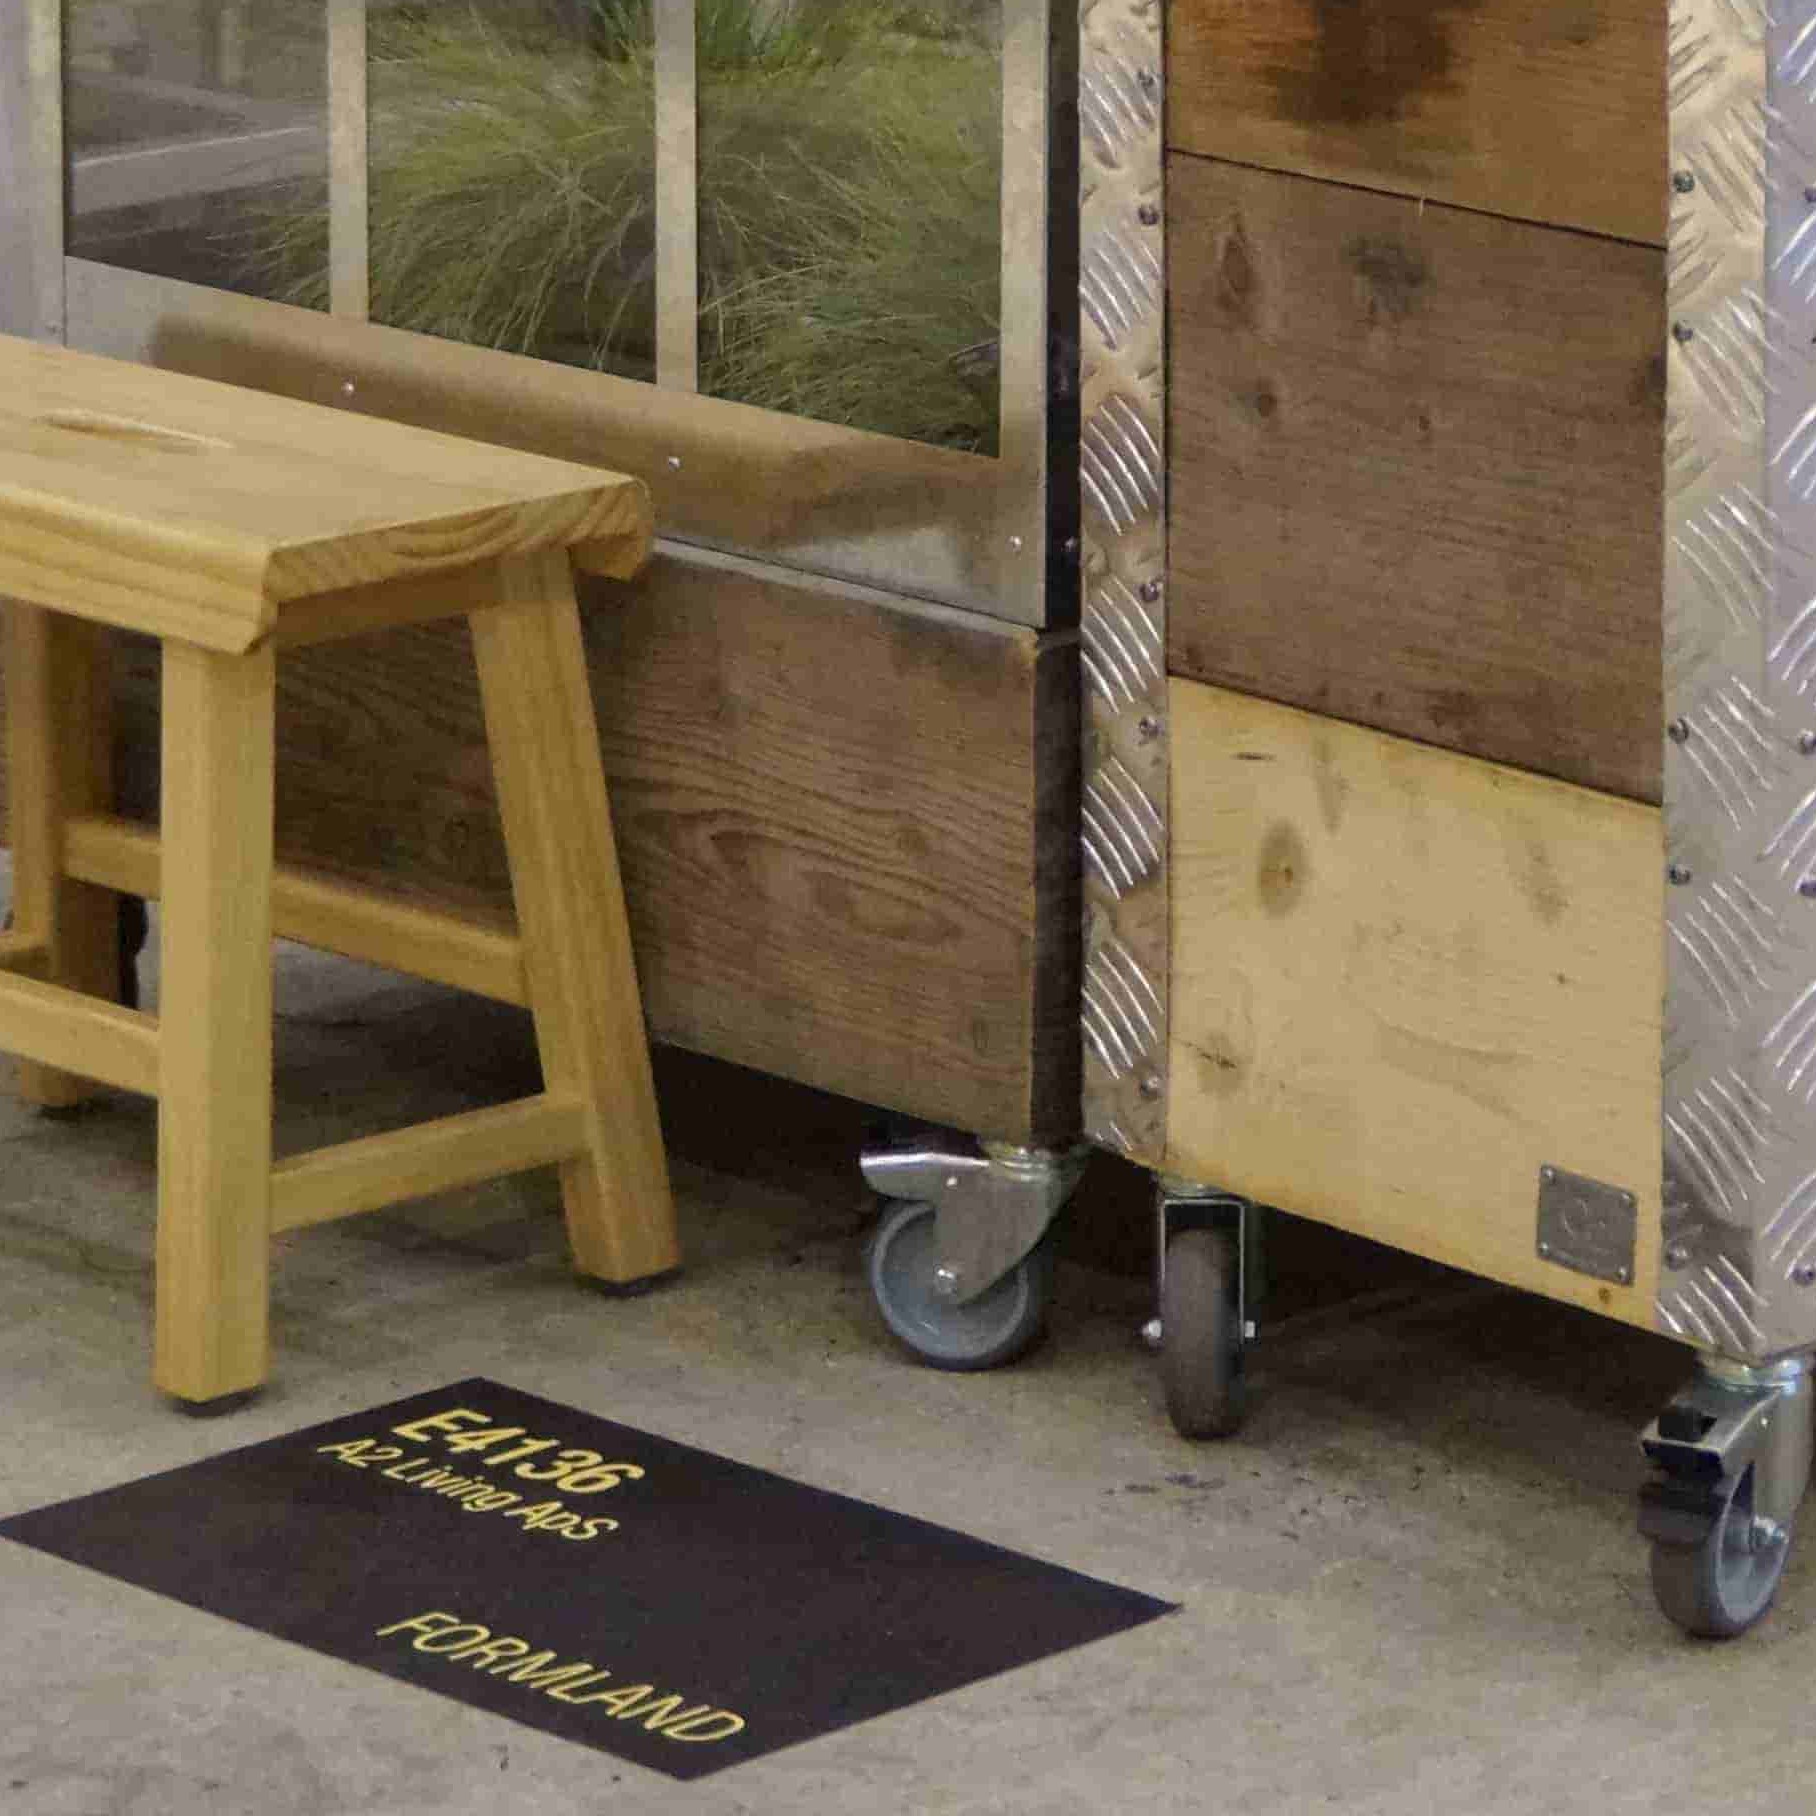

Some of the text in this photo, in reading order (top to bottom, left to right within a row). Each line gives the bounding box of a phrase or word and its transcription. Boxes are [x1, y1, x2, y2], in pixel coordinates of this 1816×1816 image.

[316, 1438, 620, 1540] A2 Living ApS
[392, 1407, 646, 1494] E4136
[375, 1610, 746, 1742] FORMLAND
